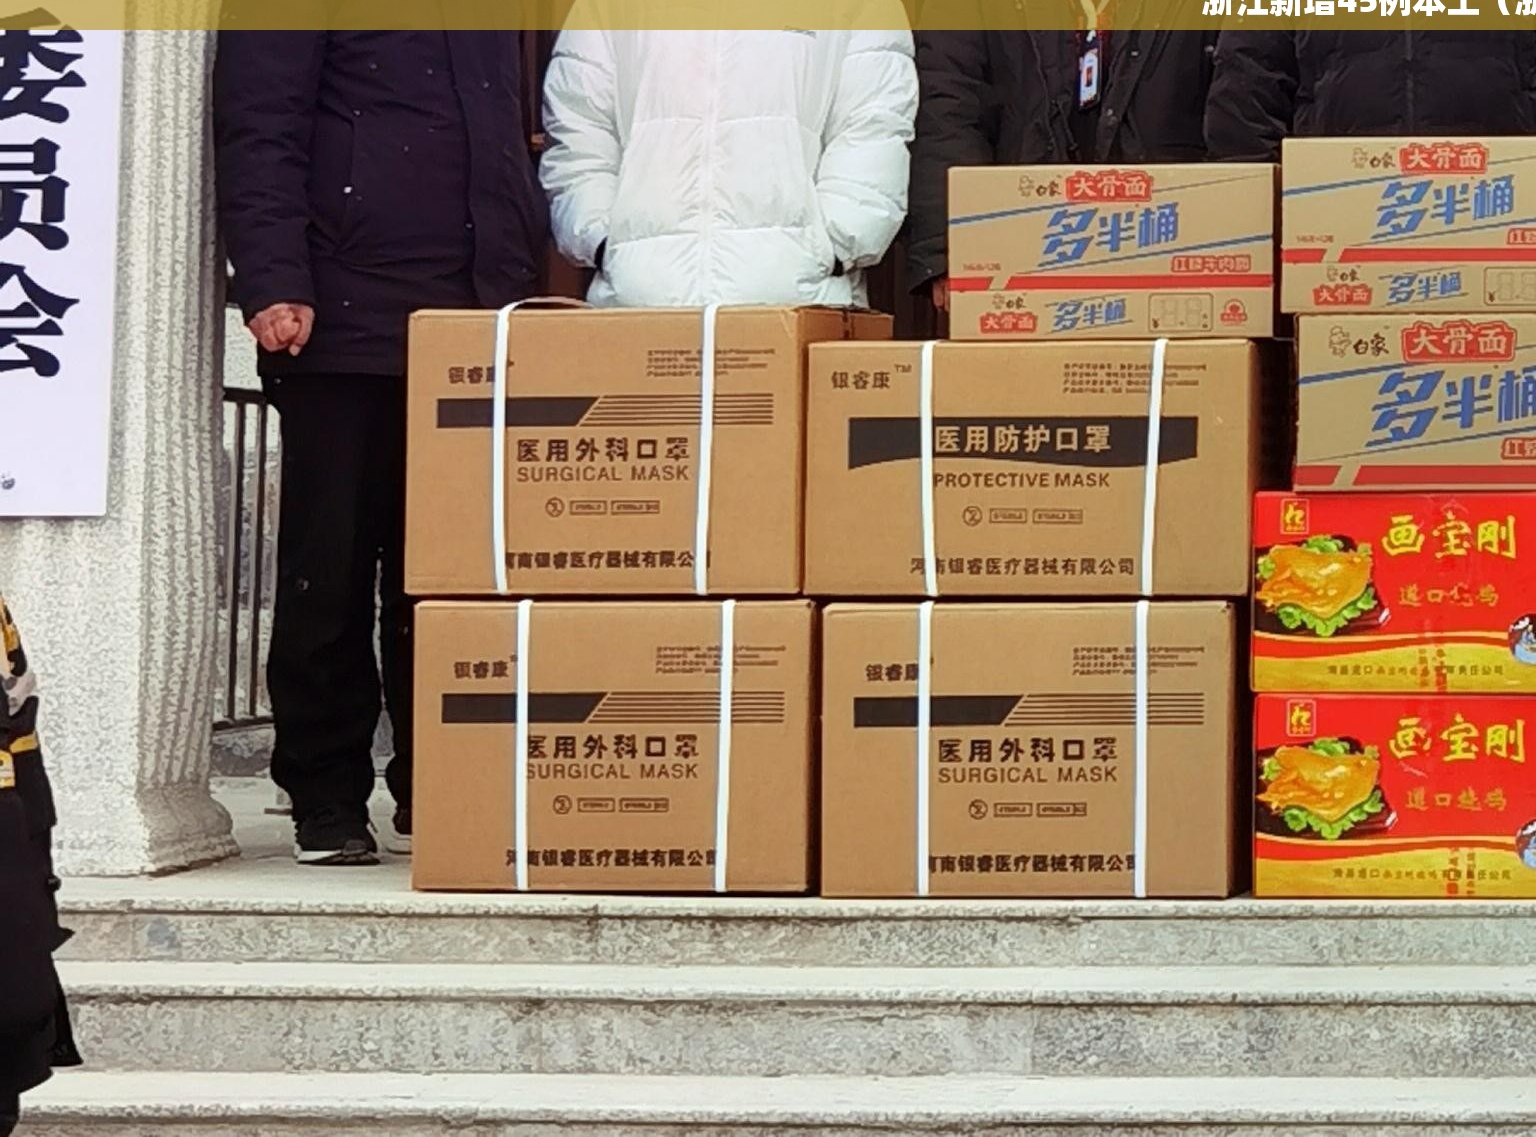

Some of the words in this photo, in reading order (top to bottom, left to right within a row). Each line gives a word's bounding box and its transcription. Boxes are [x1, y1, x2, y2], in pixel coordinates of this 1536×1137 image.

[1407, 147, 1483, 170] 大骨面
[1073, 174, 1148, 197] 大骨面
[1372, 175, 1514, 240] 多半桶
[1038, 202, 1180, 267] 多半桶
[1412, 326, 1508, 355] 大骨面
[517, 437, 690, 462] 医用外科口罩
[935, 424, 1112, 453] 医用防护口罩
[517, 465, 622, 482] SURGICAL
[631, 464, 690, 482] MASK
[933, 472, 1050, 488] PROTECTIVE
[1054, 471, 1111, 488] MASK
[527, 734, 700, 759] 医用外科口罩
[938, 737, 1118, 762] 医用外科口罩
[526, 763, 631, 780] SURGICAL
[640, 763, 699, 780] MASK
[938, 766, 1048, 783] SURGICAL
[1057, 766, 1118, 783] MASK
